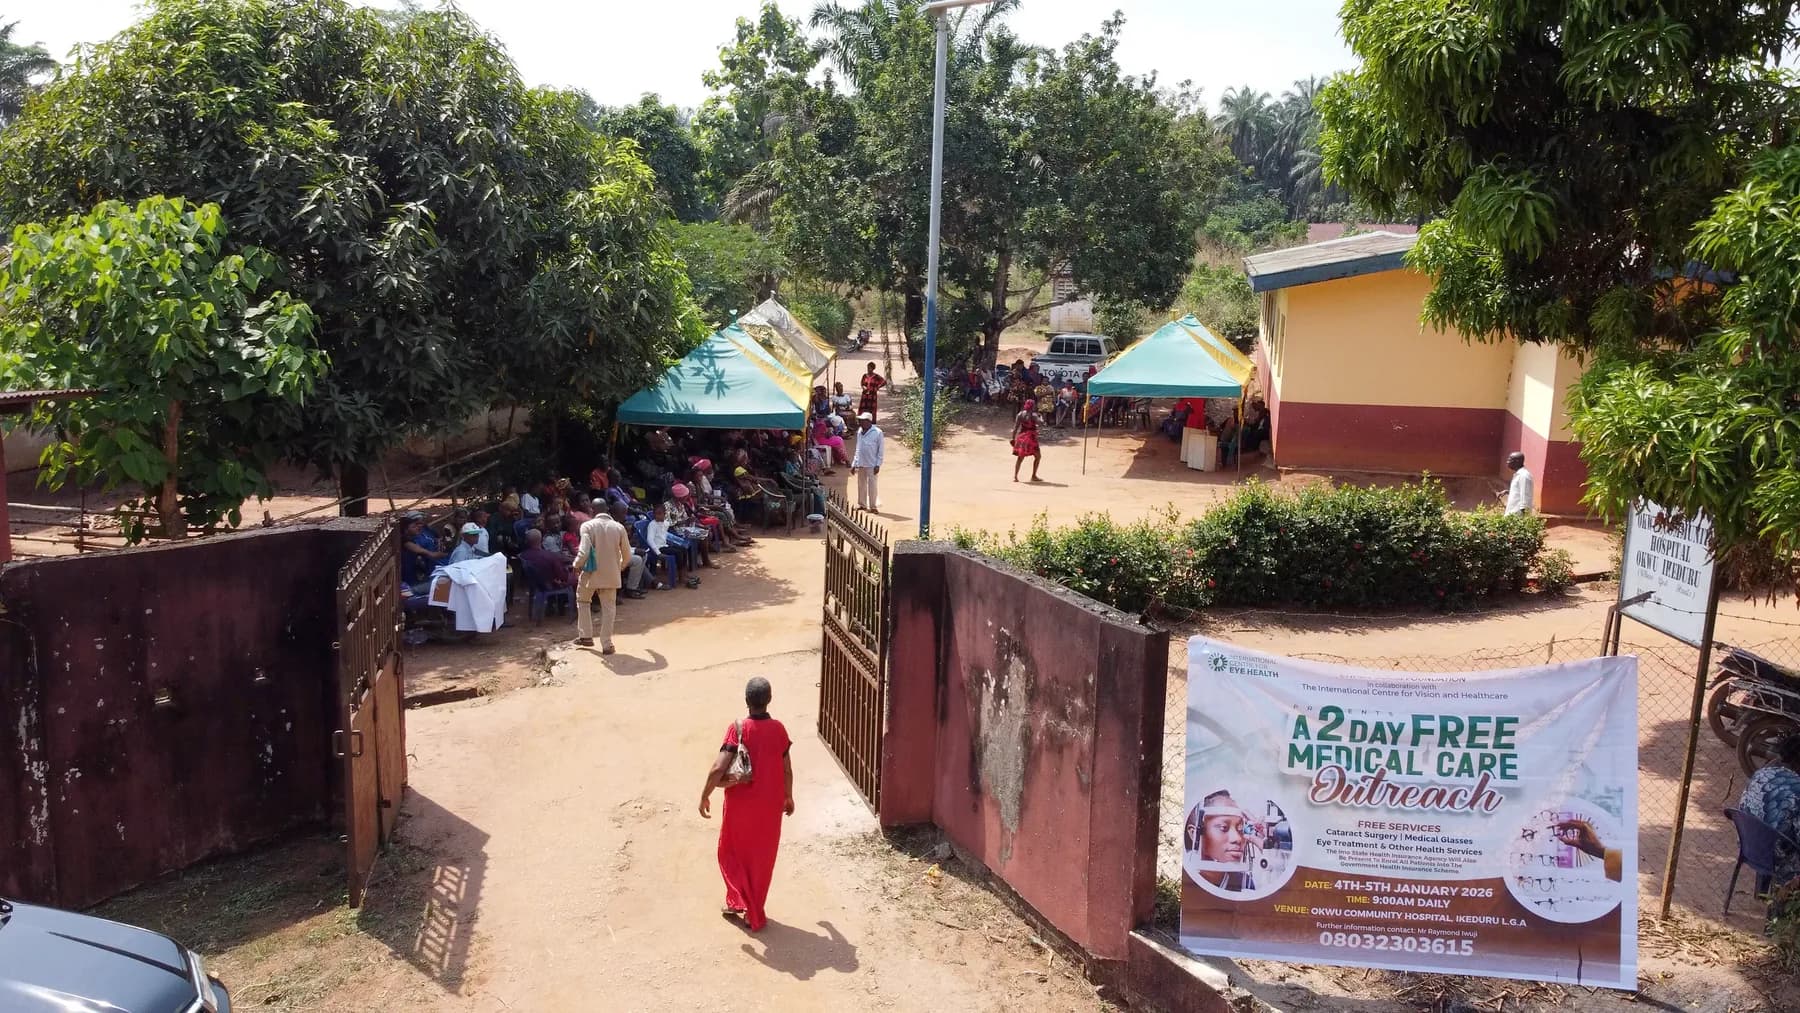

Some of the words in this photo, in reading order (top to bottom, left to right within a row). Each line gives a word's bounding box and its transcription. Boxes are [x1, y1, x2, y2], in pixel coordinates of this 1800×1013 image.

[1650, 535, 1691, 563] HOSPITAL
[1636, 550, 1659, 573] OKWU
[1662, 558, 1702, 588] IKEDURU
[1229, 666, 1246, 675] EYE
[1247, 668, 1279, 678] HEALTH
[1302, 683, 1317, 692] The
[1318, 685, 1369, 696] International
[1371, 688, 1399, 697] Centre
[1414, 691, 1440, 699] Vision
[1461, 692, 1509, 700] Healthcare
[1375, 681, 1420, 690] collaboration
[1293, 703, 1394, 717] PRENTS
[1292, 714, 1311, 740] A
[1317, 705, 1345, 742] 2
[1350, 719, 1405, 746] DAY
[1410, 714, 1520, 750] FREE
[1287, 743, 1424, 776] MEDICAL
[1436, 751, 1519, 780] CARE
[1311, 765, 1503, 812] Outreach
[1358, 820, 1386, 830] FREE
[1388, 822, 1441, 833] SERVICES
[1326, 828, 1362, 838] Cataract
[1364, 831, 1398, 842] Surgery
[1405, 833, 1439, 843] Medical
[1441, 836, 1473, 845] Glasses
[1316, 838, 1332, 848] Eye
[1333, 840, 1378, 849] Treatment
[1389, 843, 1414, 852] Other
[1416, 845, 1445, 854] Health
[1447, 847, 1483, 856] Services
[1340, 861, 1379, 869] Government
[1380, 863, 1401, 871] Health
[1392, 852, 1422, 860] Insurance
[1424, 855, 1449, 863] Agency
[1304, 880, 1333, 890] DATE:
[1334, 880, 1391, 893] 4TH-5TH
[1394, 884, 1459, 897] JANUARY
[1461, 887, 1494, 898] 2026
[1346, 895, 1370, 904] TIME:
[1372, 896, 1415, 907] 9:00AM
[1417, 898, 1451, 908] DAILY
[1274, 904, 1309, 914] VENUE:
[1311, 907, 1342, 917] OKWU
[1344, 909, 1403, 919] COMMUNITY
[1456, 915, 1500, 925] IKEDURU
[1501, 918, 1527, 928] L.G.A
[1316, 922, 1342, 930] Further
[1344, 923, 1386, 932] information
[1387, 926, 1416, 934] contact:
[1428, 928, 1460, 937] Raymond
[1461, 930, 1478, 938] Iwuji
[1320, 931, 1474, 956] 08032303615
